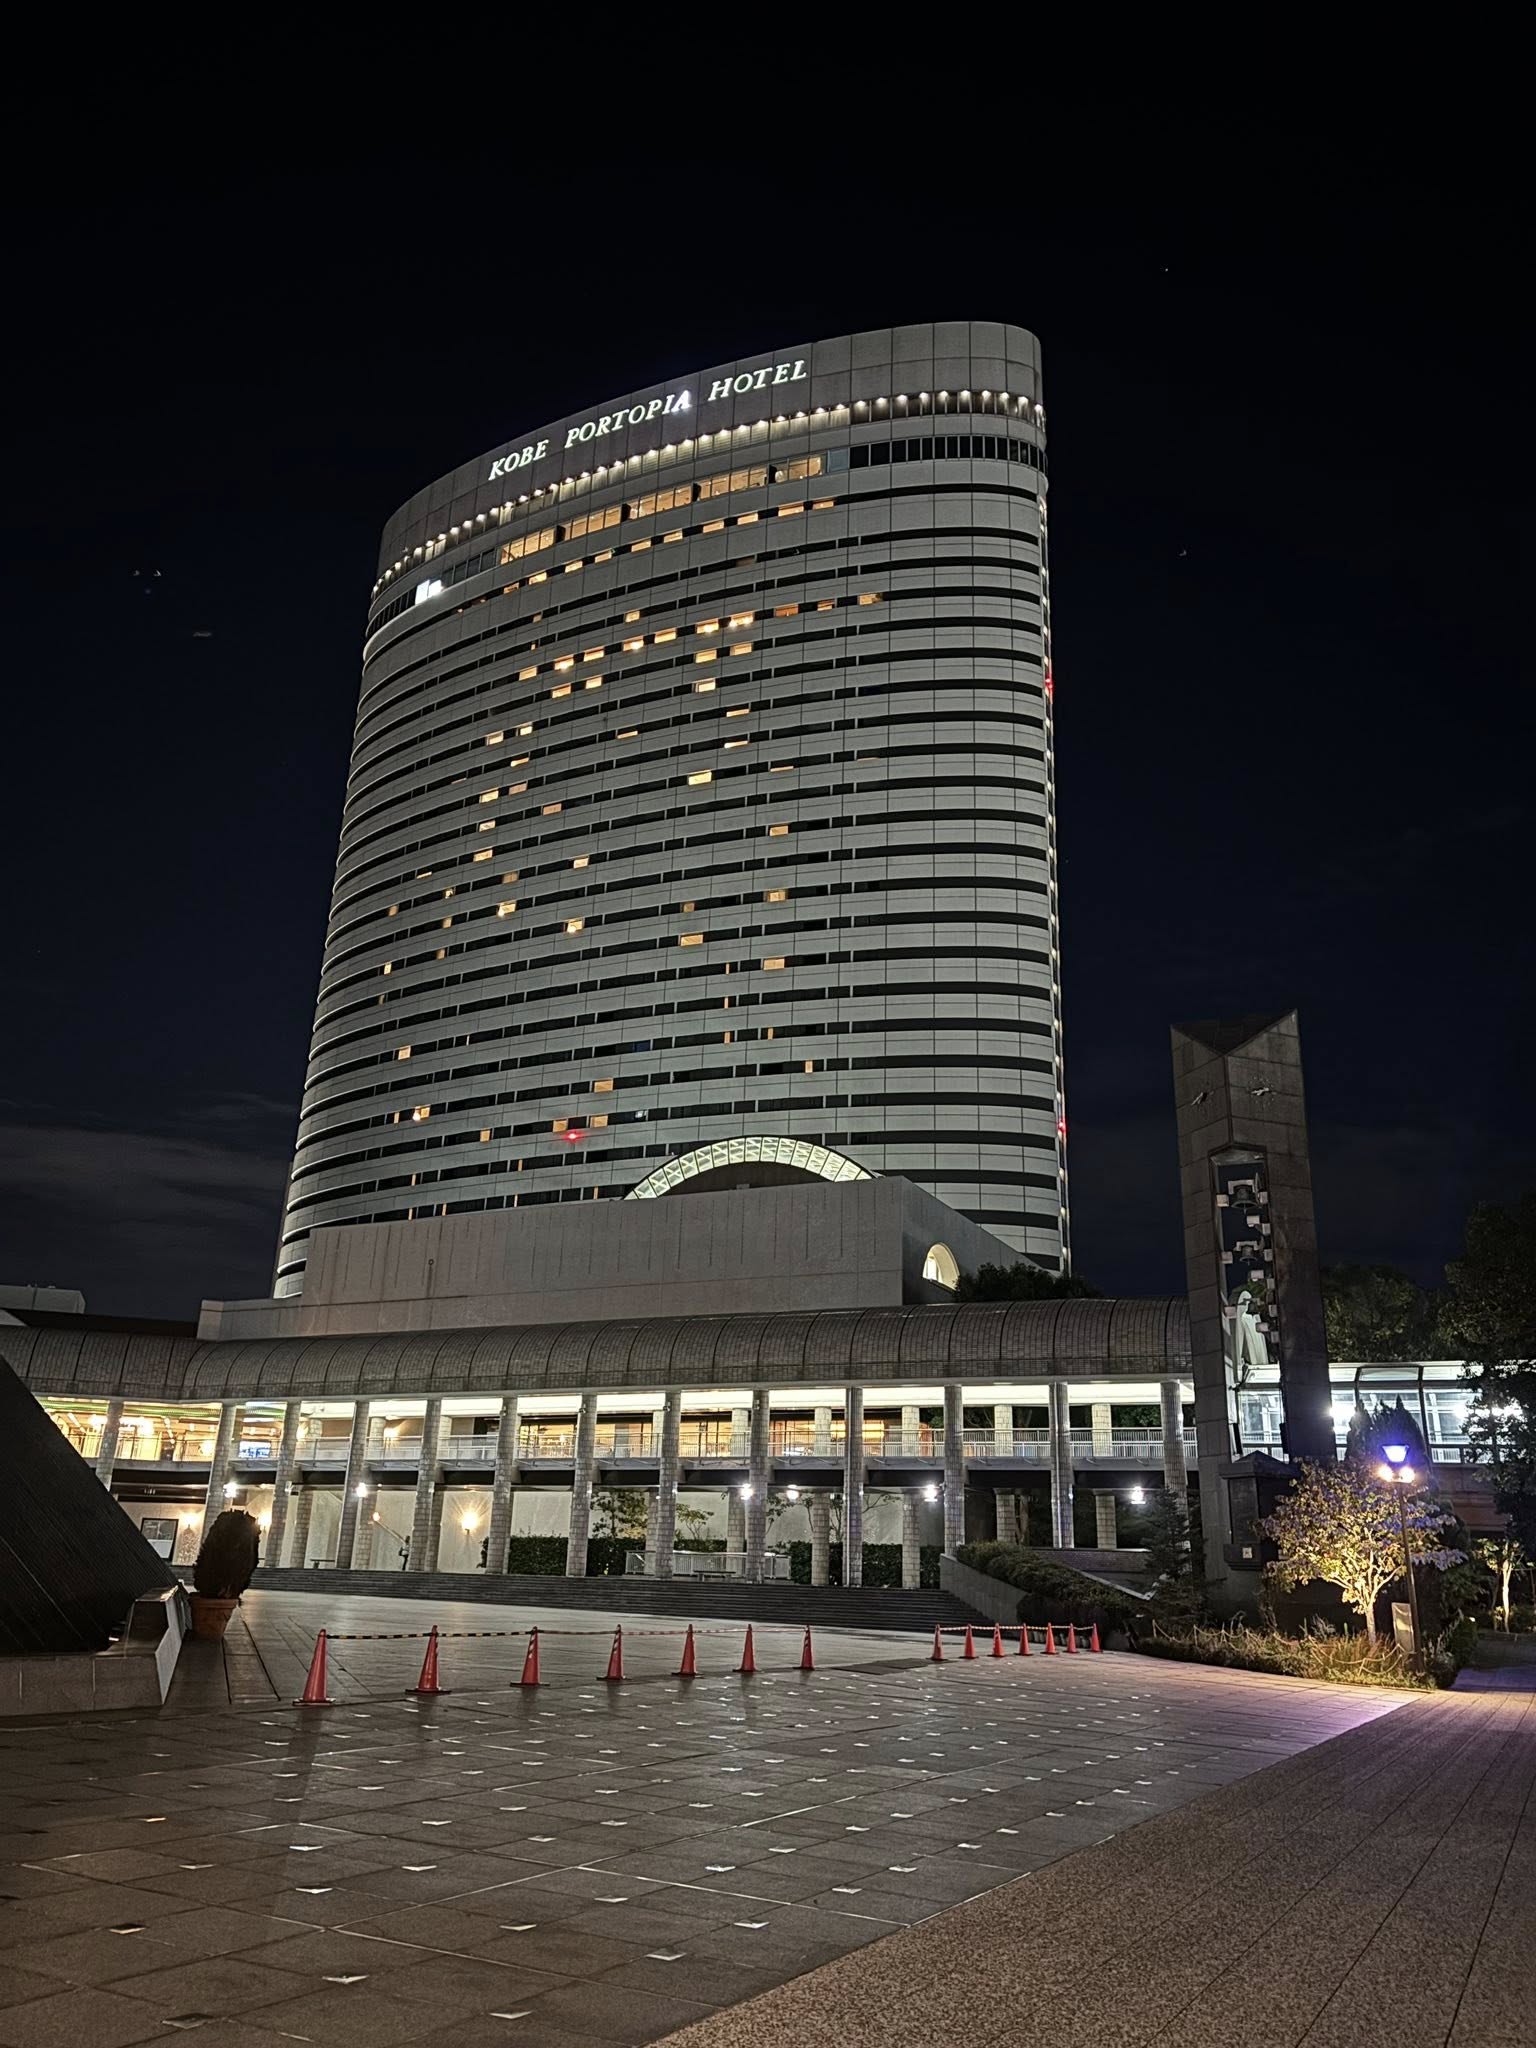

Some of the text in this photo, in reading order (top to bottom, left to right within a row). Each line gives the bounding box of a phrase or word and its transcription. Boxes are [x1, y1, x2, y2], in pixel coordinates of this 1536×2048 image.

[487, 359, 807, 481] KOBE PORTOPIA HOTEL
